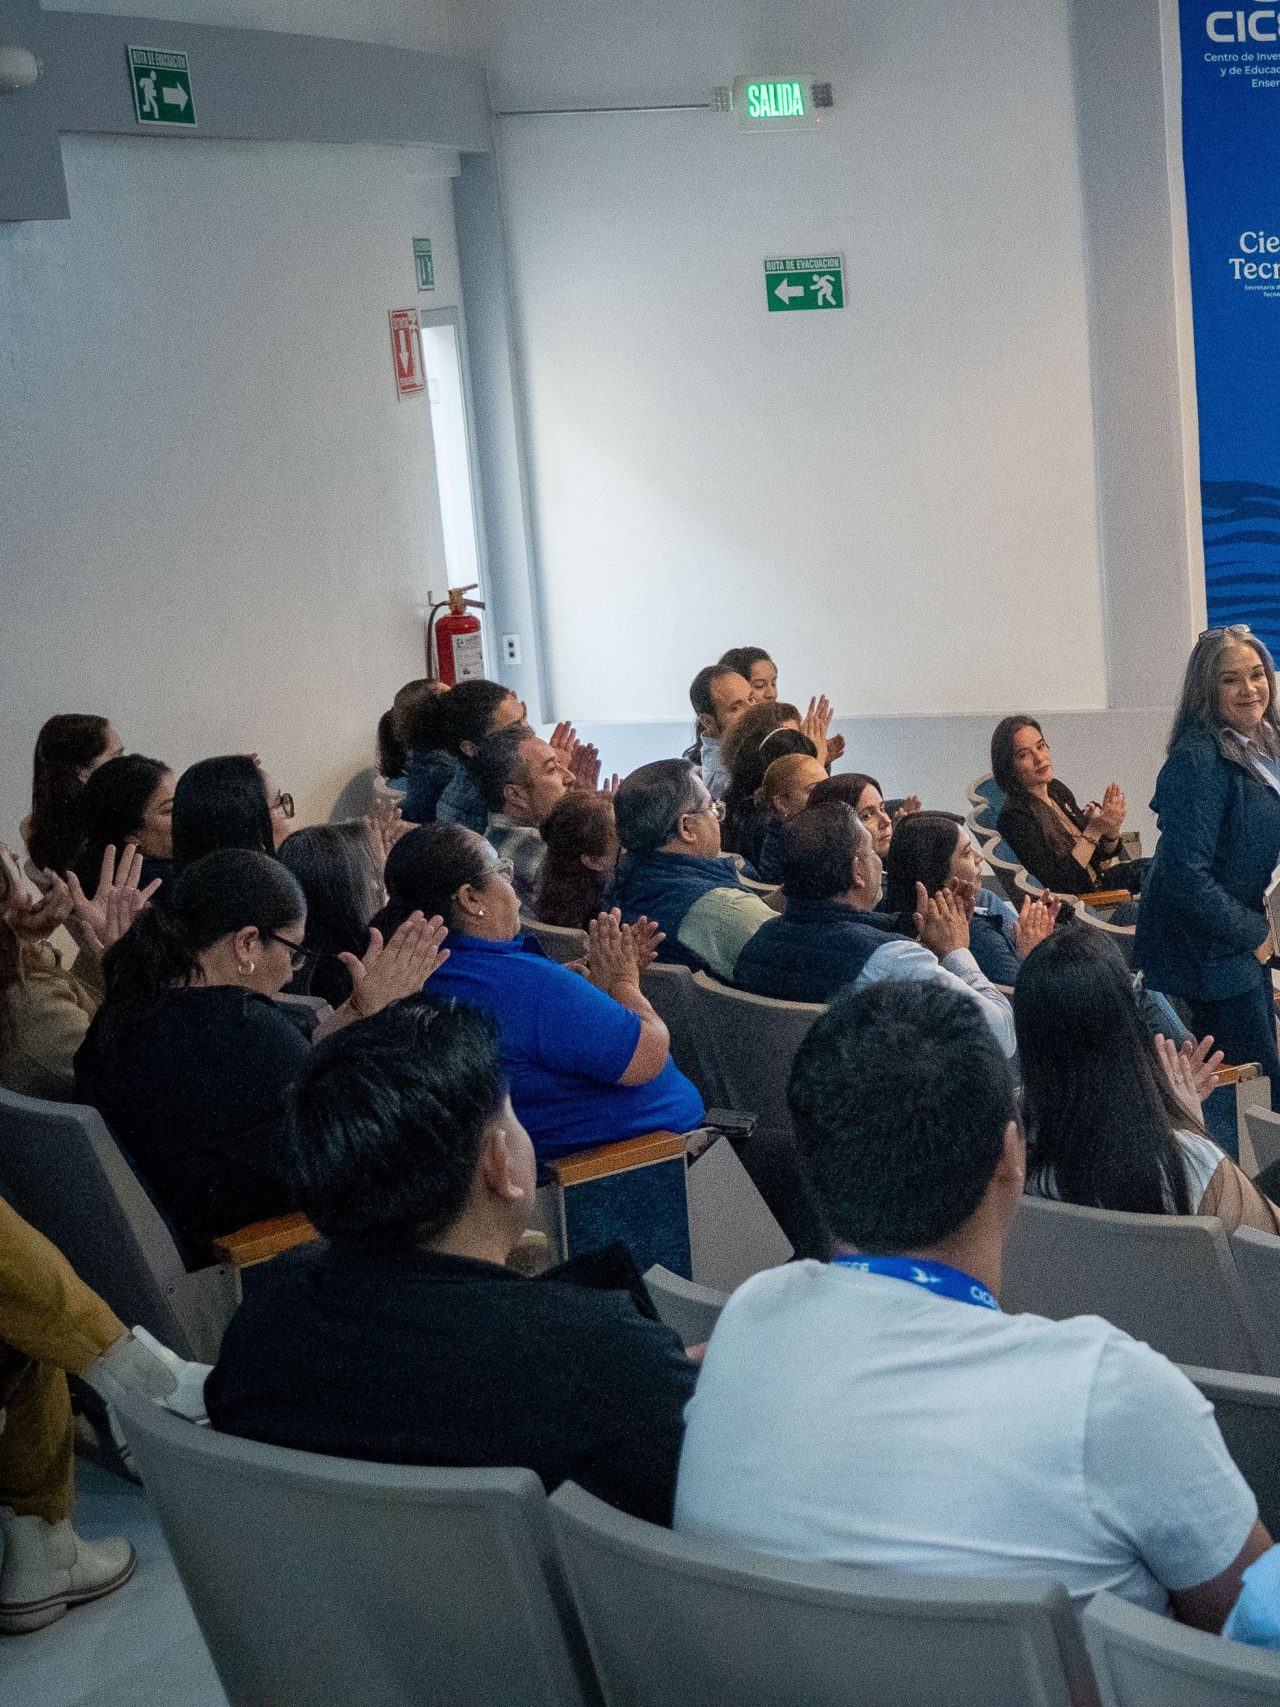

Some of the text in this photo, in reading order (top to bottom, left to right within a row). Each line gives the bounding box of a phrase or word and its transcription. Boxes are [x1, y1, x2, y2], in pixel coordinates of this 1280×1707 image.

[1203, 52, 1239, 62] Centro
[1241, 52, 1254, 61] de
[1220, 67, 1227, 77] y
[1229, 66, 1242, 75] de
[748, 82, 804, 118] SALIDA
[766, 260, 785, 271] RUTA
[785, 260, 796, 270] DE
